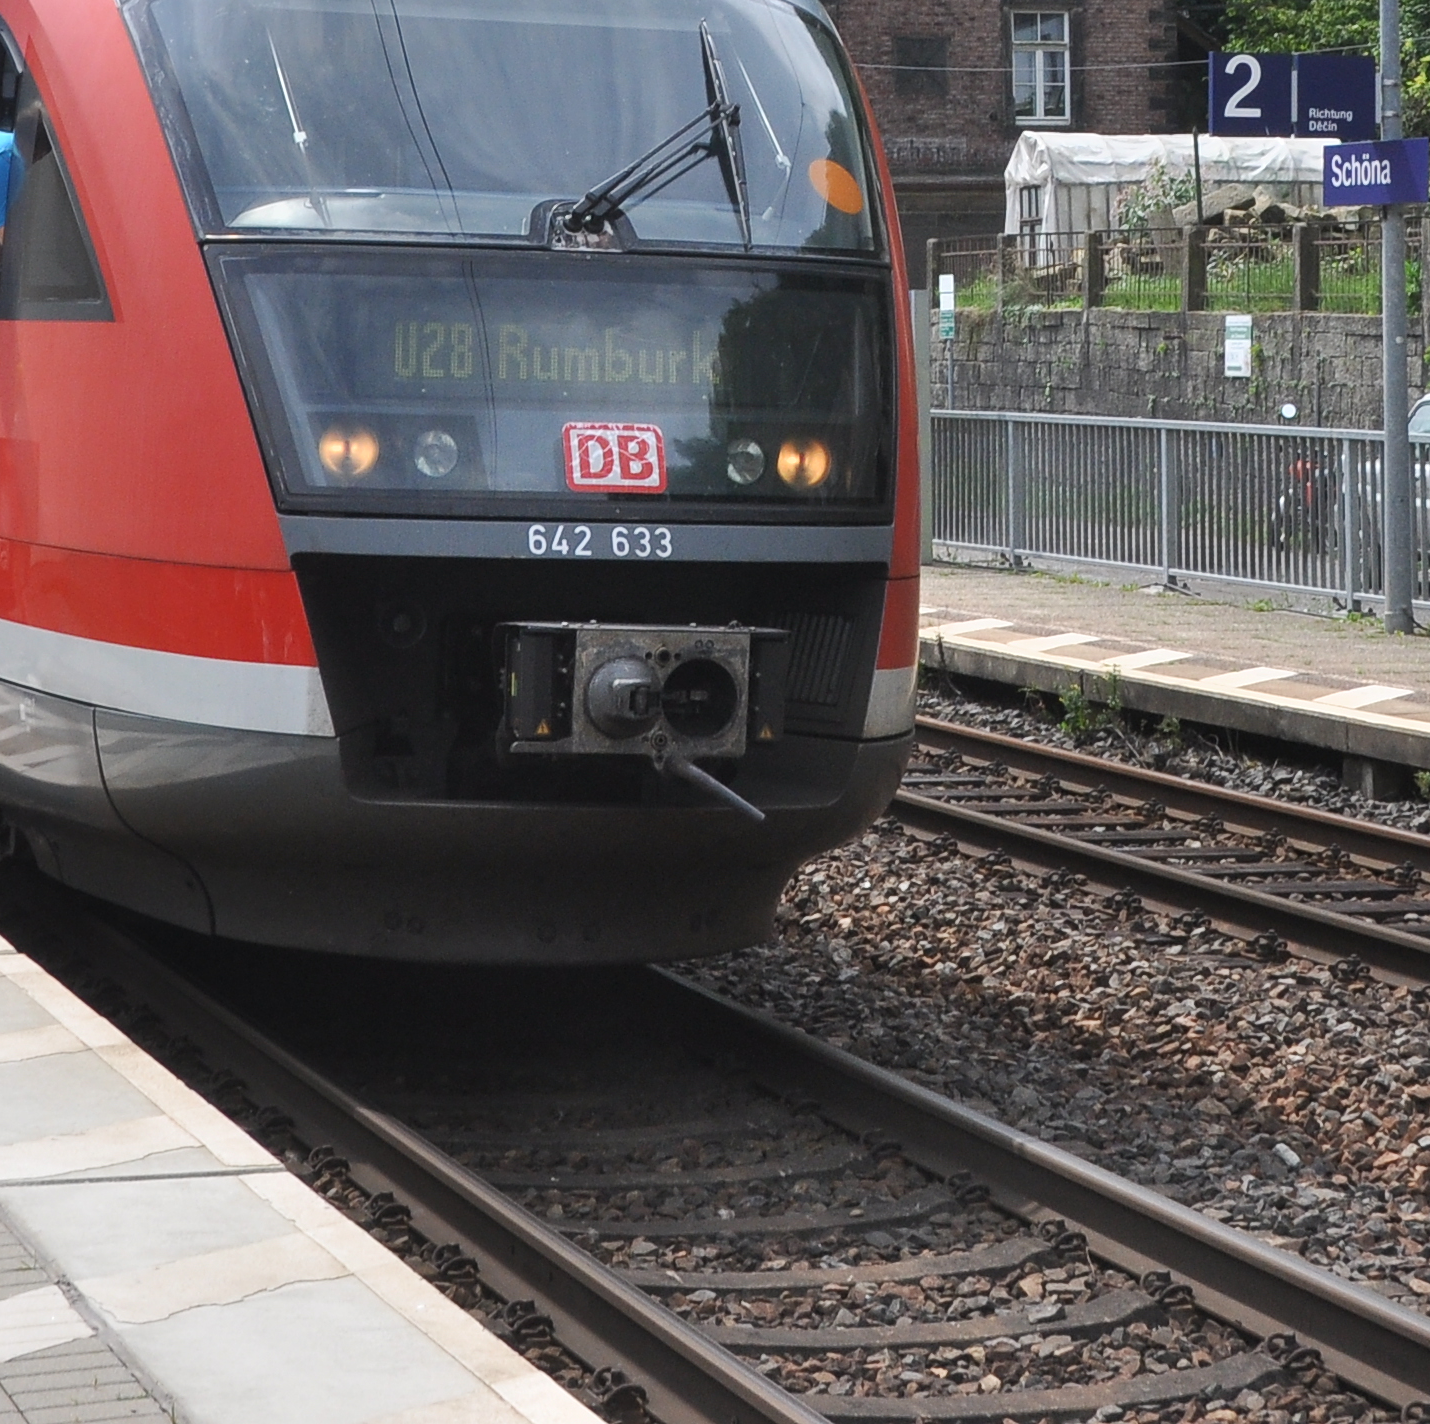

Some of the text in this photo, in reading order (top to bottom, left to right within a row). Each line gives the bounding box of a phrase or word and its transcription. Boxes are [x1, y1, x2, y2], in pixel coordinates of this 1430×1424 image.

[1224, 54, 1261, 117] 2
[1308, 107, 1353, 122] Richtung
[1331, 153, 1391, 187] Schöna
[395, 323, 720, 384] U28 Rumburk
[576, 433, 654, 480] DB
[528, 525, 672, 558] 642 633
